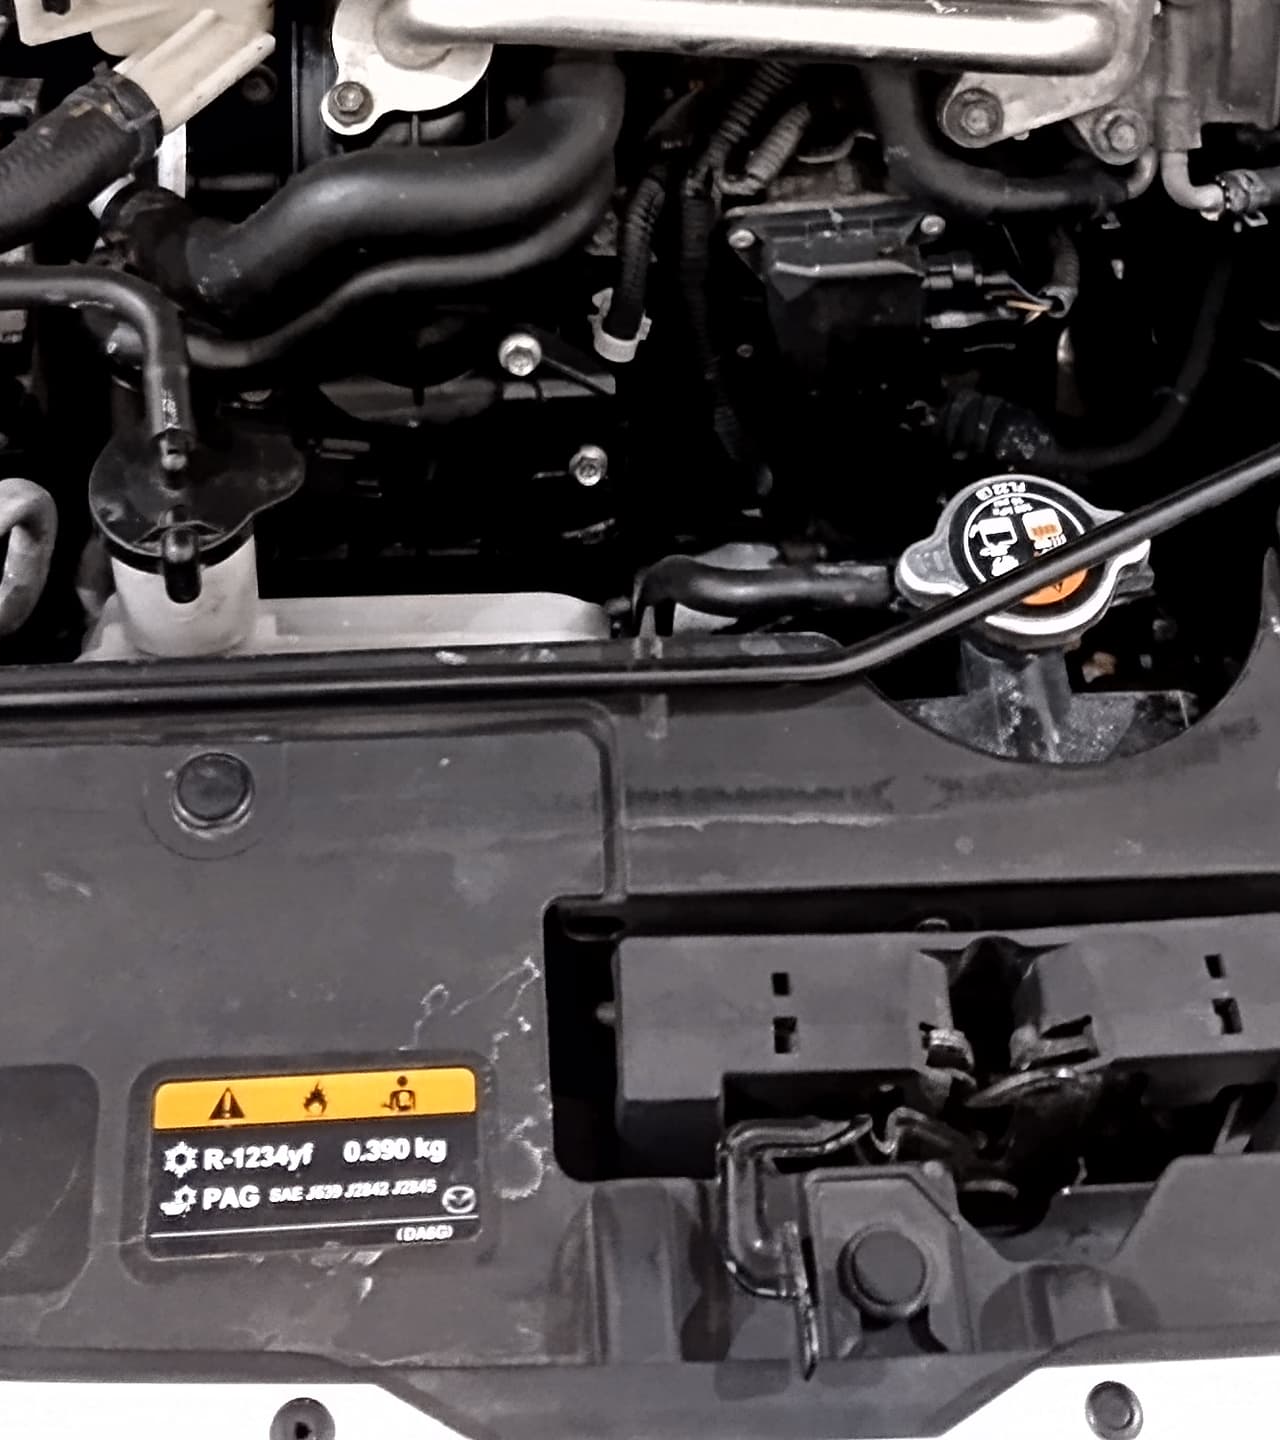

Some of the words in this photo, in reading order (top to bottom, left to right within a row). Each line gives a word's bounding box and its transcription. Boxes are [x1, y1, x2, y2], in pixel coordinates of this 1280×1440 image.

[203, 1142, 315, 1172] R-1234yf
[343, 1138, 410, 1163] 0.390
[414, 1136, 447, 1163] kg
[202, 1185, 261, 1211] PAG
[269, 1186, 303, 1203] SAE
